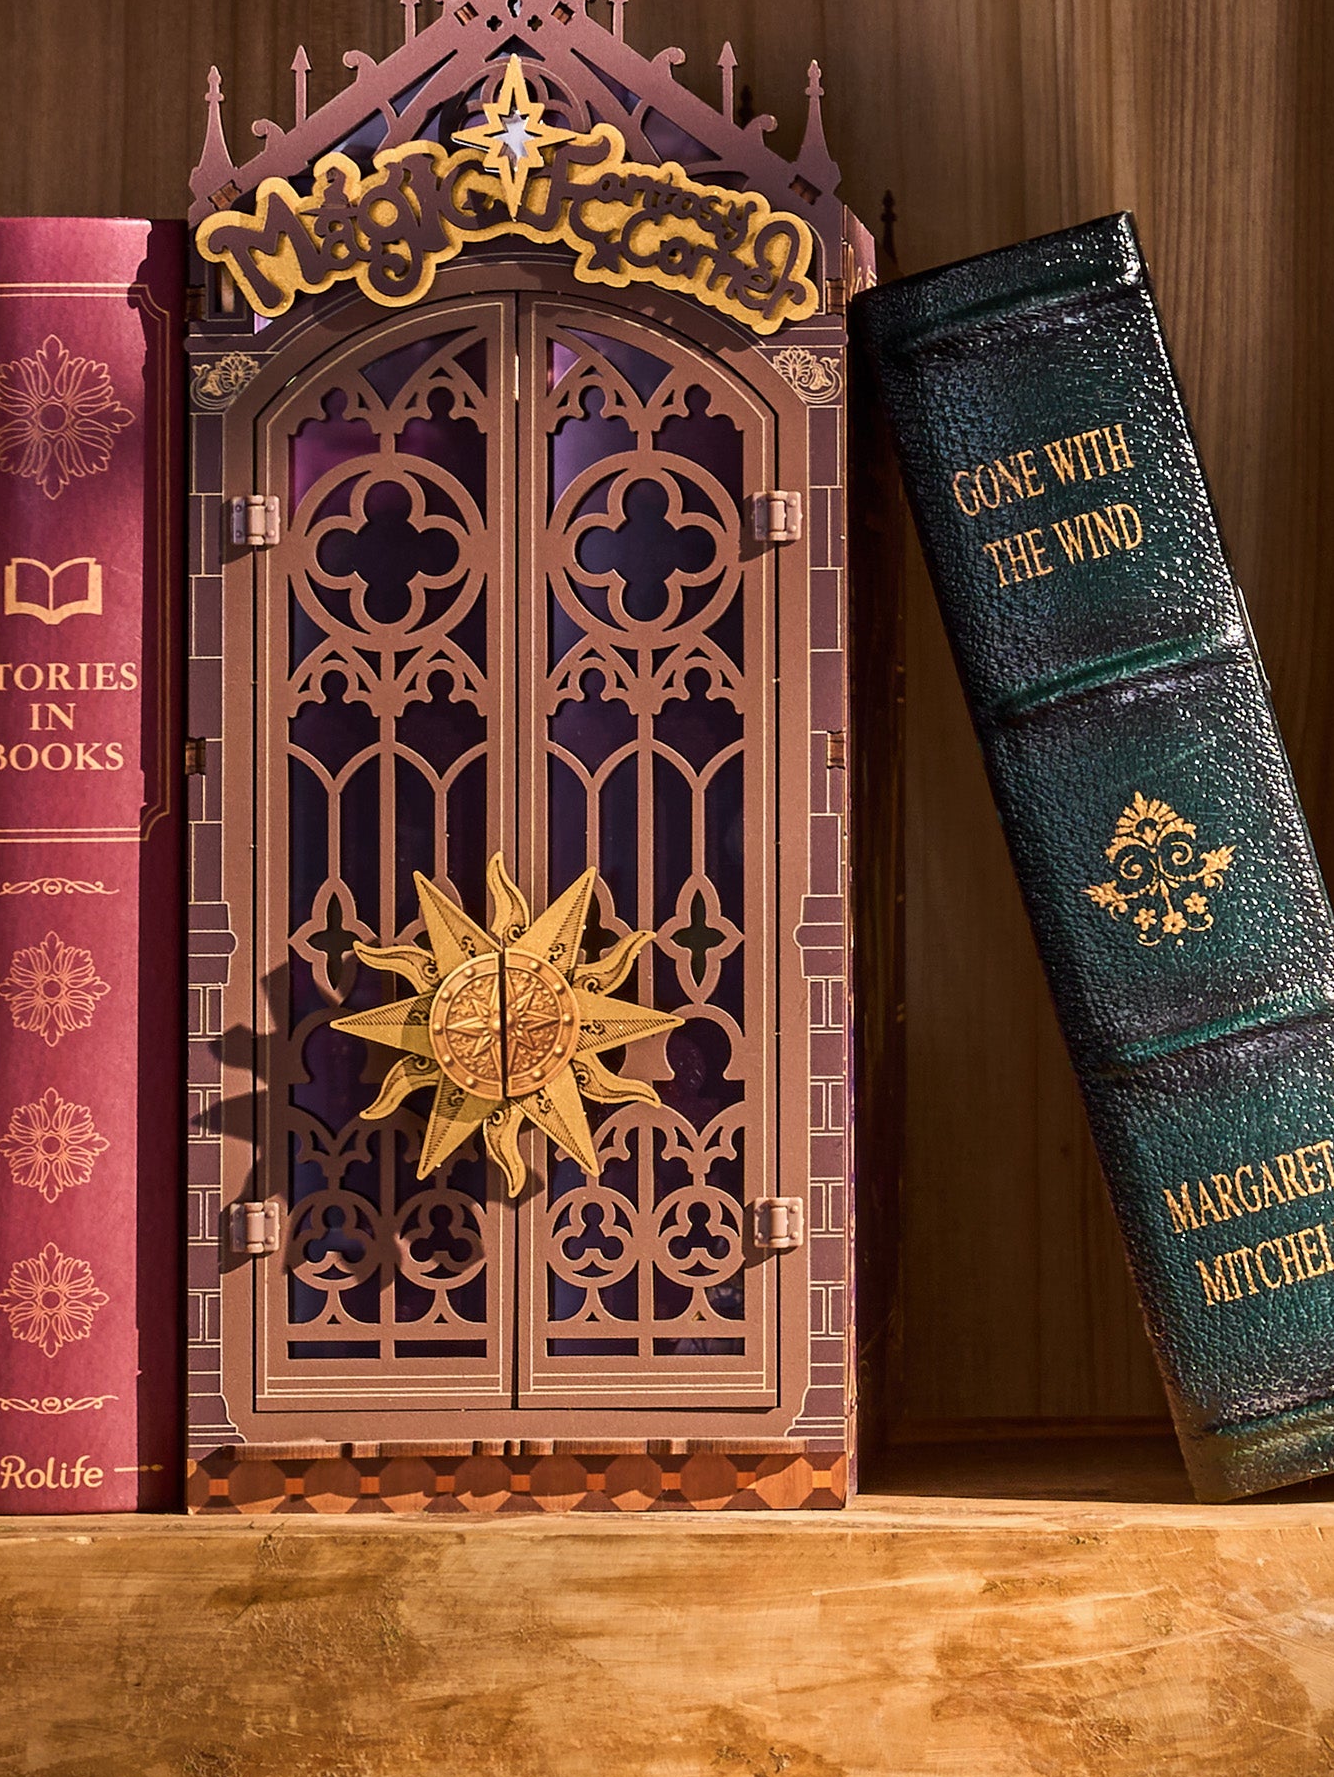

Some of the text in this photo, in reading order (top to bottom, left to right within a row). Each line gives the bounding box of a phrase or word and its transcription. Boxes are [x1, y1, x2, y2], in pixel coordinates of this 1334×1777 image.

[207, 152, 510, 308] Magic
[952, 422, 1135, 518] GONE WITH
[982, 502, 1144, 589] THE WIND
[28, 702, 76, 733] IN
[0, 1453, 105, 1491] Rolife
